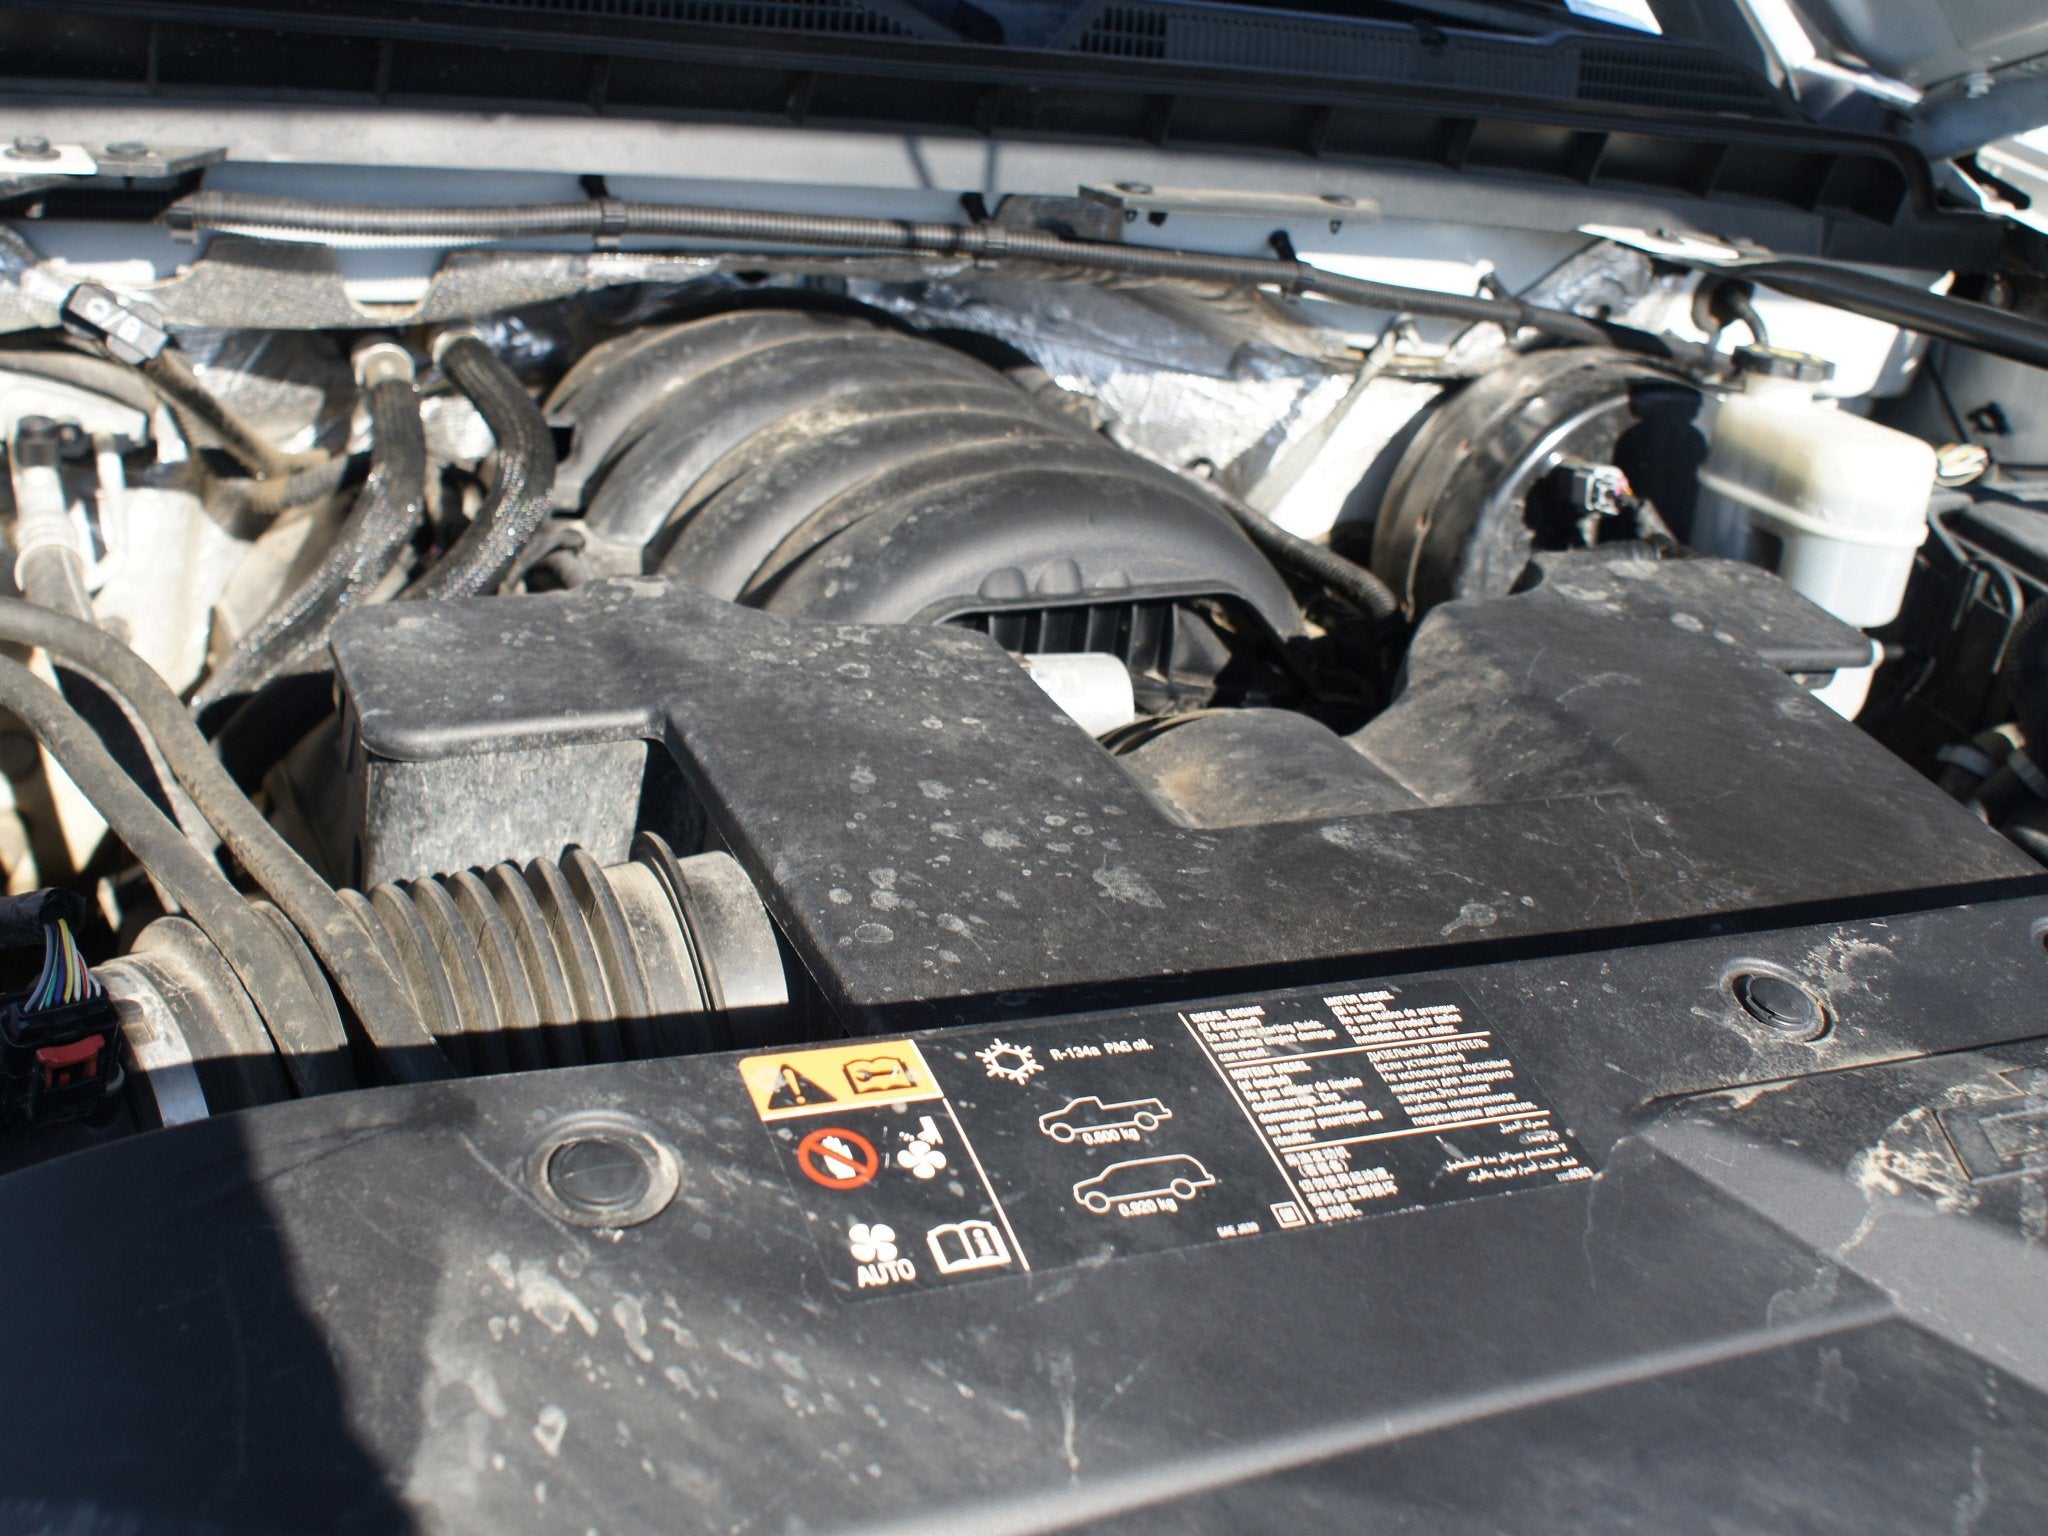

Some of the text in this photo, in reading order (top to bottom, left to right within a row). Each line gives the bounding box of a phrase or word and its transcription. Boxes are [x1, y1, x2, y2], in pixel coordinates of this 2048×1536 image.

[1219, 1029, 1239, 1041] not
[1103, 1040, 1133, 1054] PAG
[1366, 1038, 1489, 1063] ДИЗЕЛЬНЫЙ ДВИГАТЕЛЬ
[1218, 1051, 1239, 1063] can
[1119, 1127, 1141, 1141] kg
[1156, 1197, 1178, 1213] kg
[857, 1258, 916, 1288] AUTO
